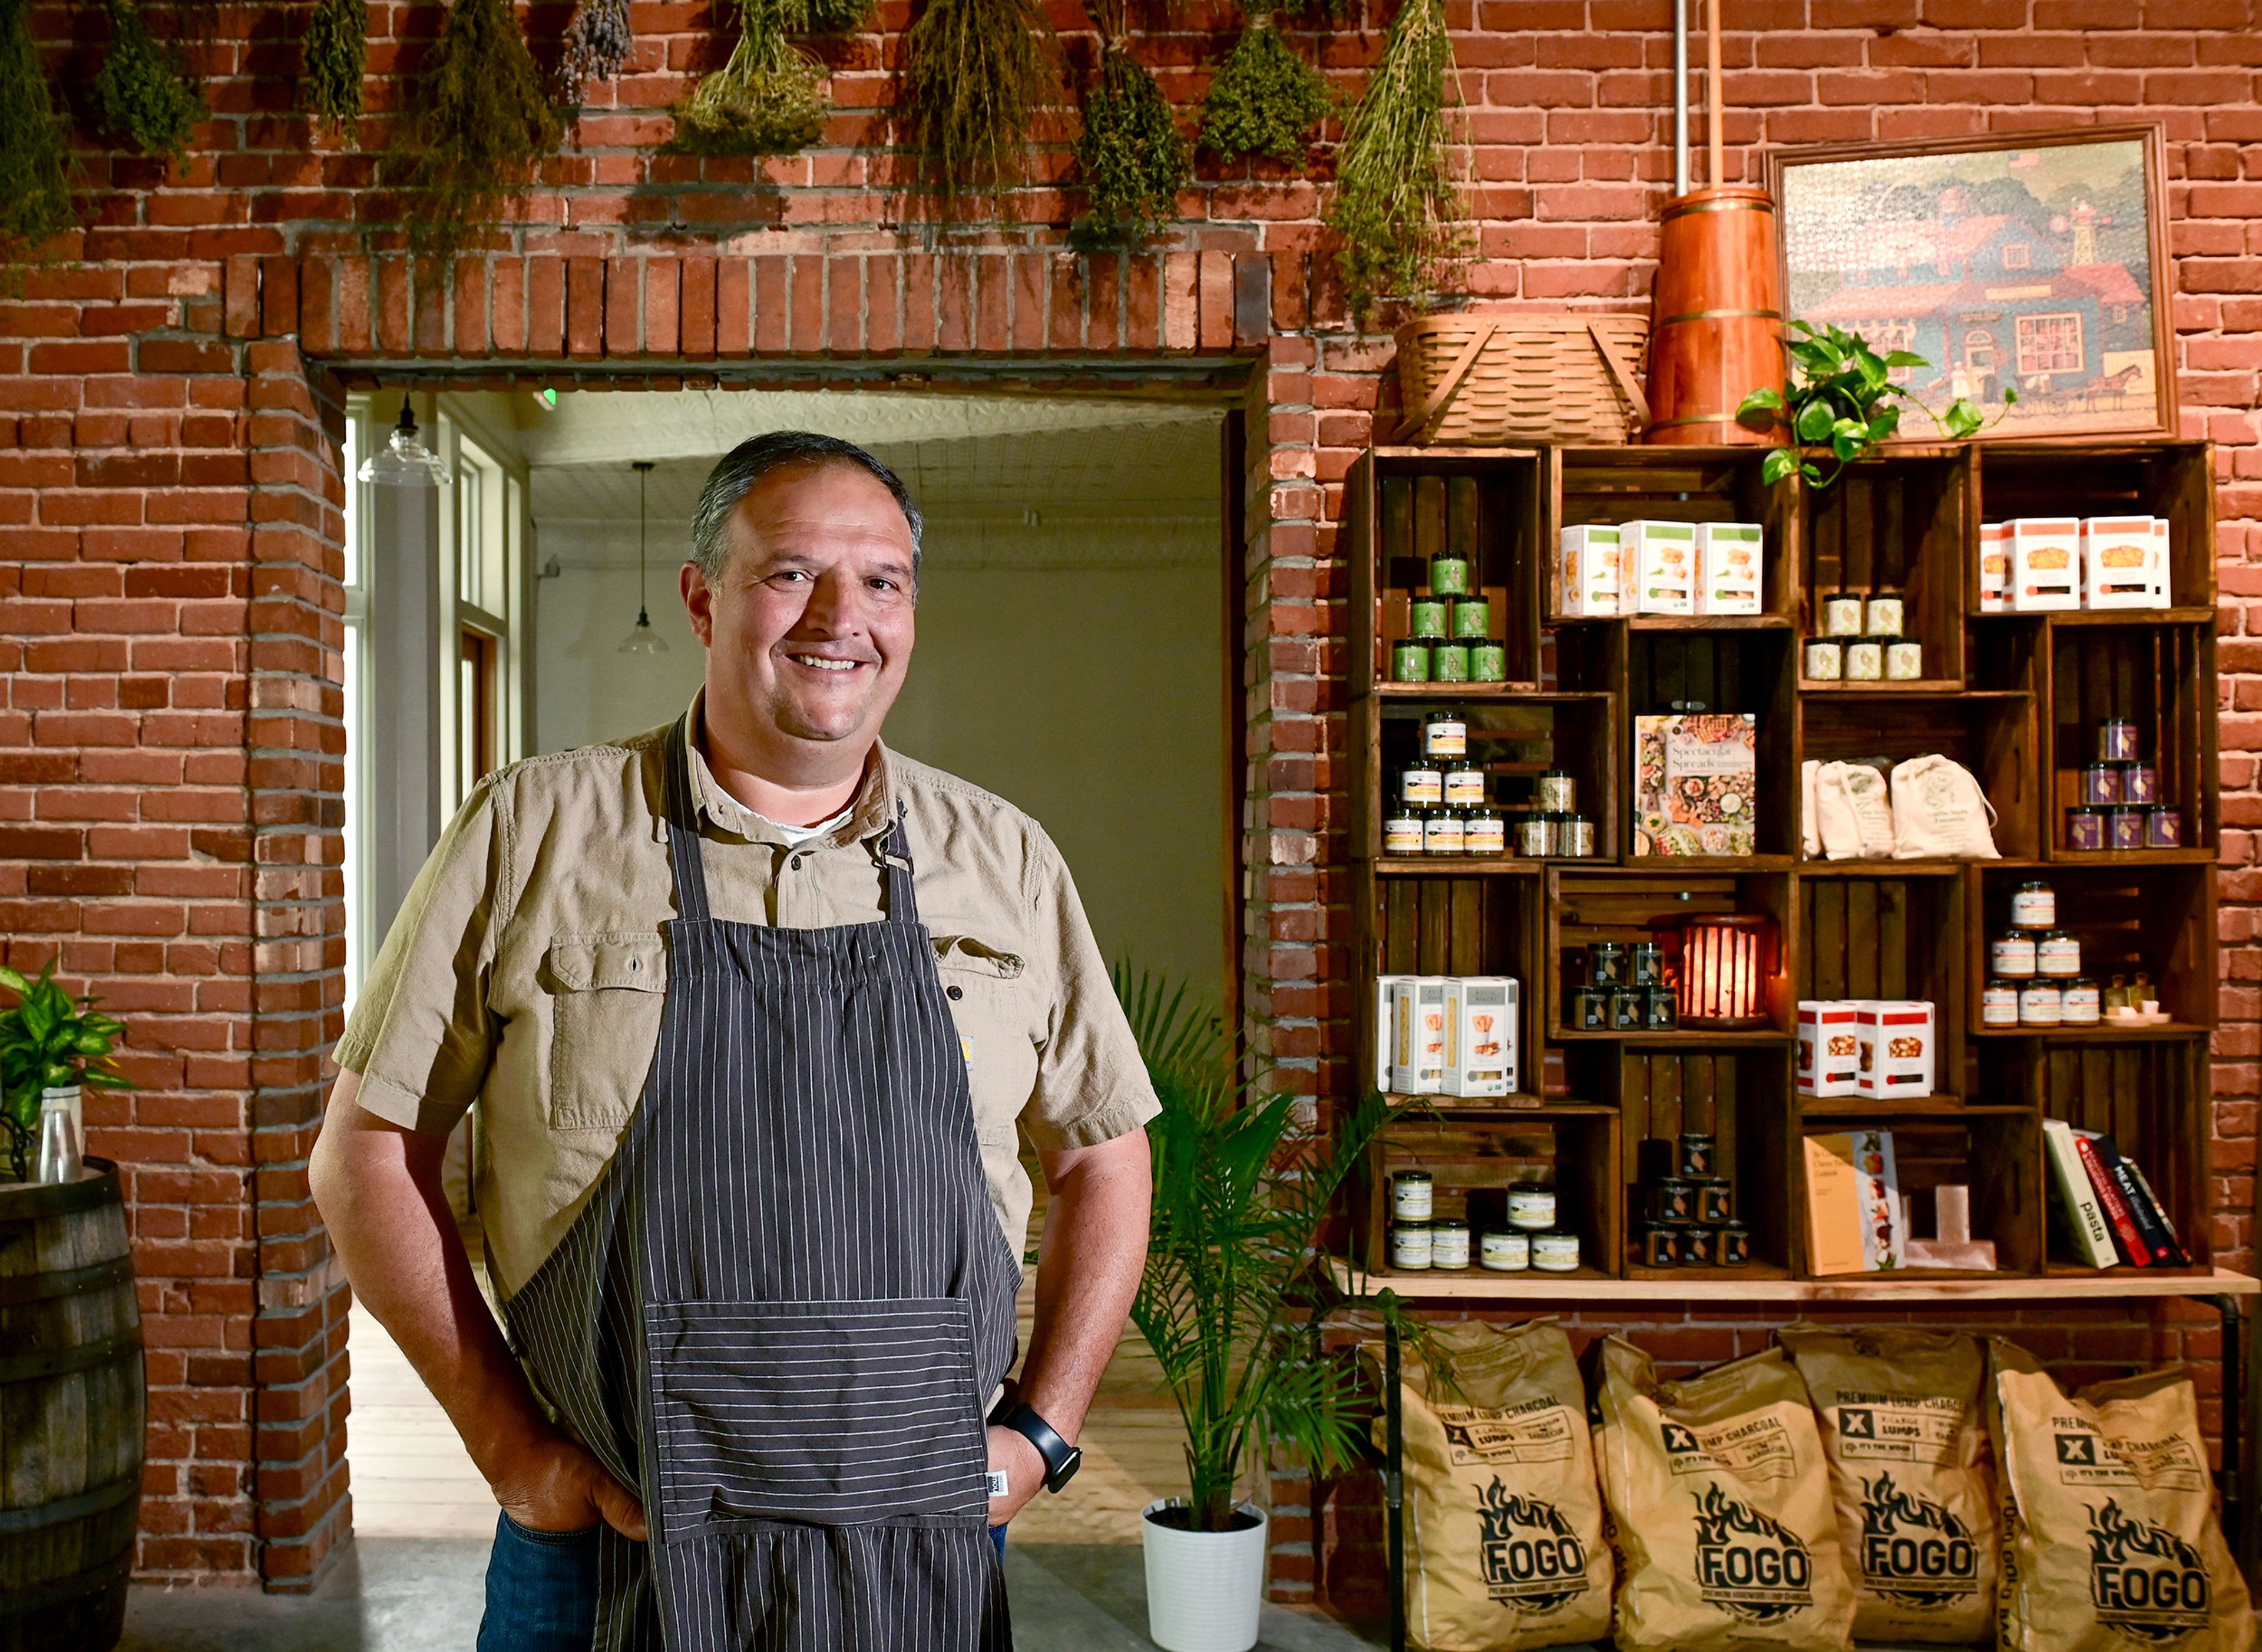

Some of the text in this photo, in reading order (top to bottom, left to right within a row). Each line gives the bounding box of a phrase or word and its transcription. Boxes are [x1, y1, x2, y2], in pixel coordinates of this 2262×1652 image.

[1672, 745, 1731, 759] Spectacular
[1672, 759, 1715, 771] Spreads
[2114, 1165, 2137, 1196] MEAT
[2079, 1201, 2105, 1243] pasta
[1504, 1394, 1560, 1420] CHARCOAL
[1836, 1390, 1888, 1405] PREMIUM
[1725, 1416, 1783, 1442] CHARCOAL
[1882, 1425, 1922, 1437] LUMPS
[1487, 1537, 1584, 1581] FOGO
[1702, 1547, 1807, 1587] FOGO
[1868, 1537, 1973, 1577] FOGO
[2097, 1565, 2206, 1609] FOGO
